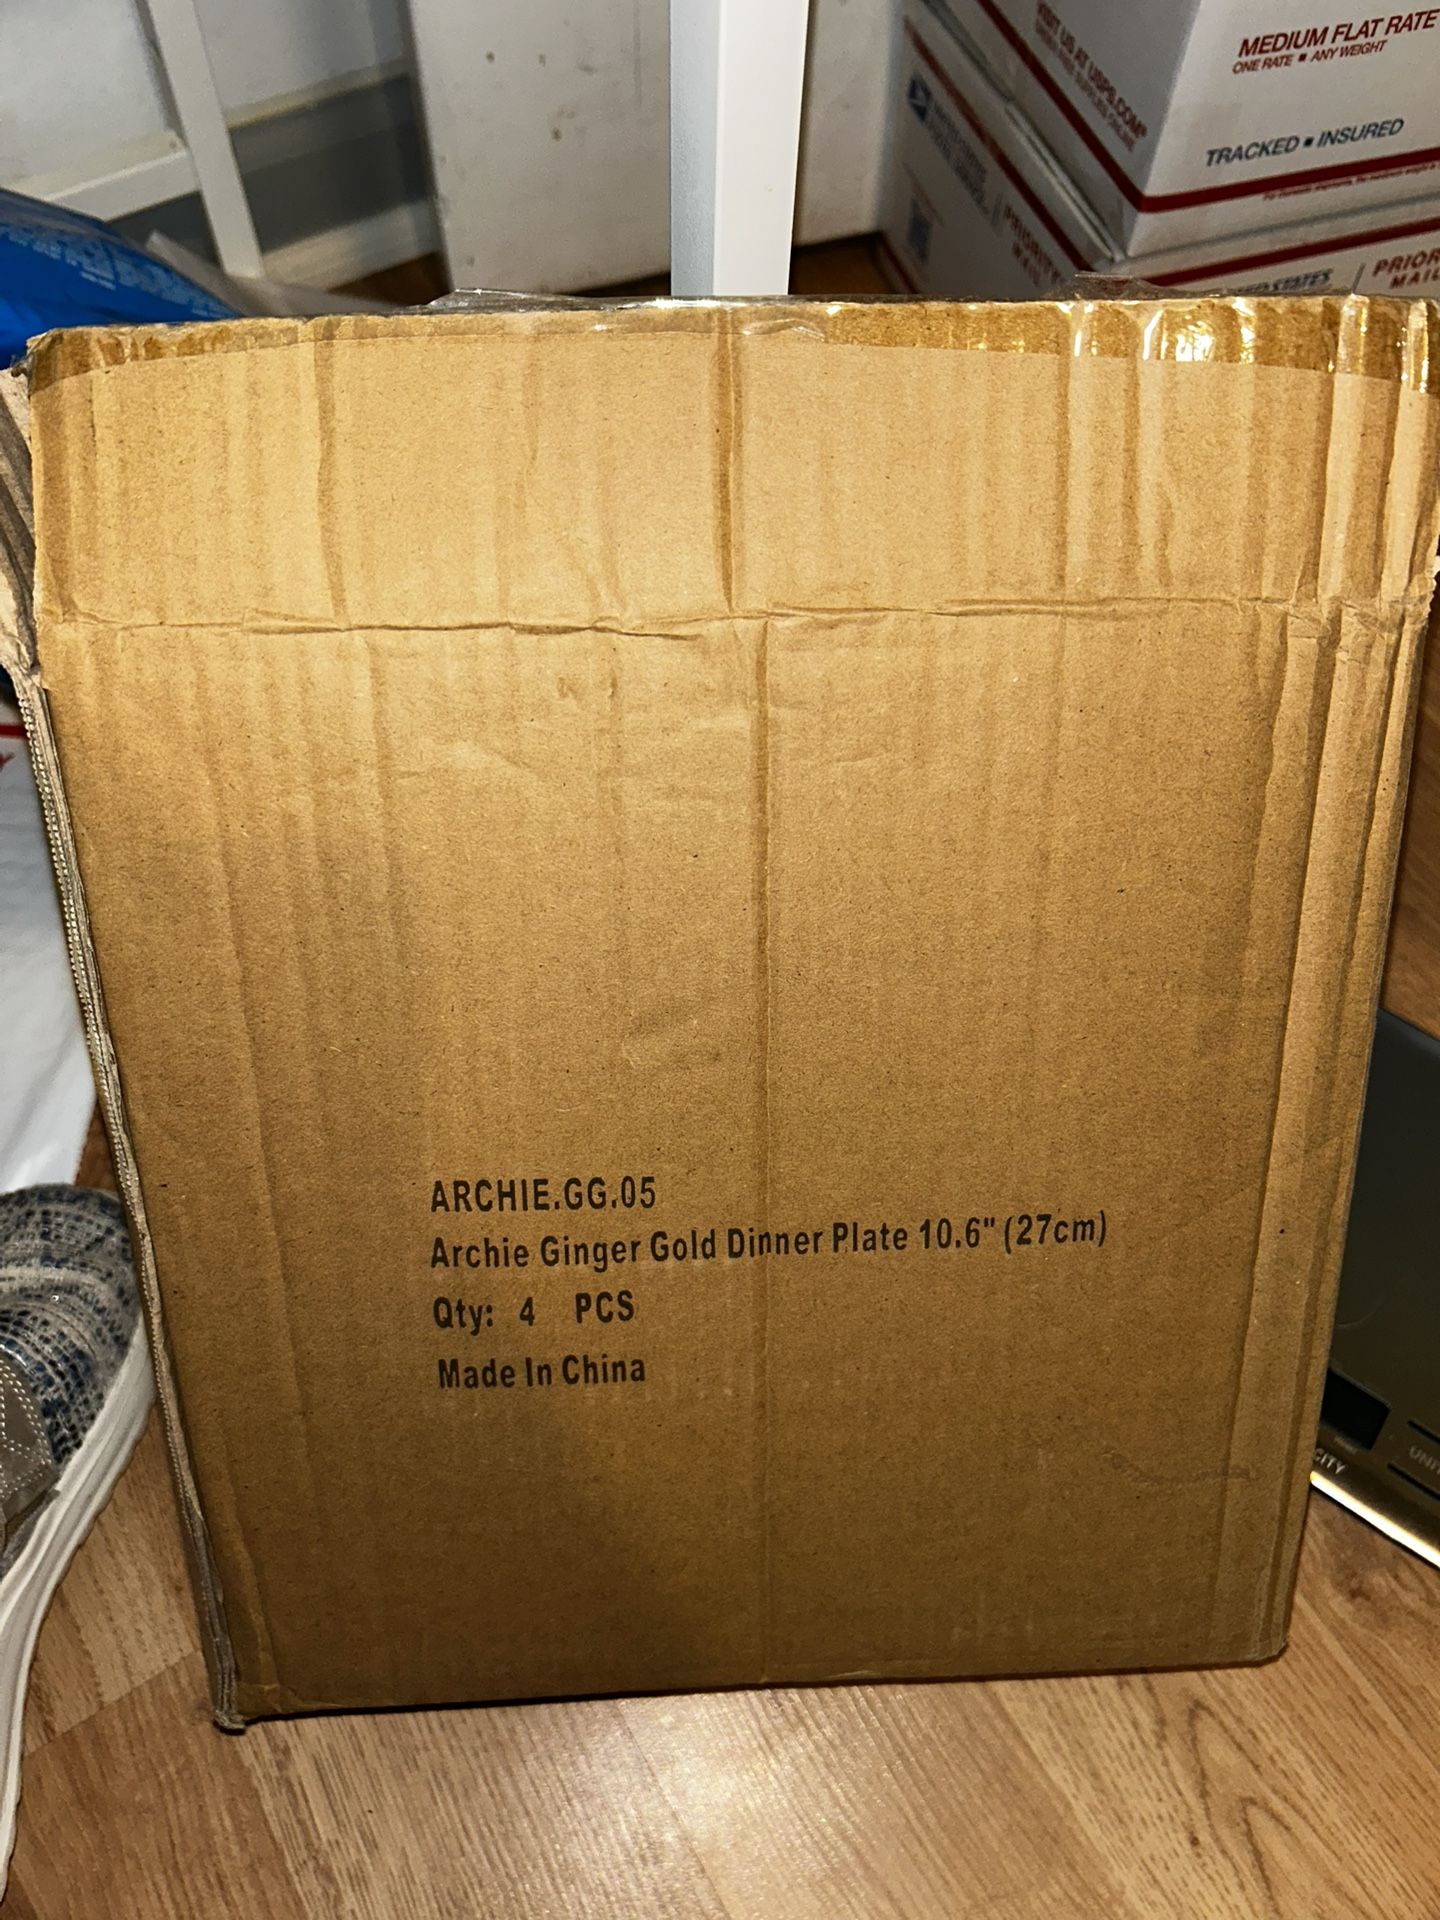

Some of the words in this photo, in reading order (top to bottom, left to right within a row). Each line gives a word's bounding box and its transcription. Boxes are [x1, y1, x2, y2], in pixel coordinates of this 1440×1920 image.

[1232, 58, 1259, 75] ONE
[1261, 53, 1294, 70] RATE
[1310, 47, 1340, 63] ANY
[1339, 39, 1388, 58] WEIGHT
[1238, 26, 1329, 58] MEDIUM
[1331, 17, 1384, 44] FLAT
[1385, 8, 1440, 36] RATE
[1205, 135, 1300, 167] TRACKED
[1317, 117, 1405, 149] INSURED
[430, 1175, 657, 1214] ARCHIE.GG.05
[430, 1236, 531, 1269] Archie
[540, 1235, 643, 1275] Ginger
[649, 1228, 718, 1263] Gold
[727, 1227, 825, 1259] Dinner
[832, 1221, 909, 1254] Plate
[918, 1216, 997, 1250] 10.6"
[1003, 1209, 1108, 1255] (27cm)
[432, 1296, 495, 1337] Qty:
[518, 1296, 537, 1327] 4
[574, 1289, 636, 1325] PCS
[437, 1357, 517, 1390] Made
[525, 1356, 554, 1388] In
[561, 1353, 647, 1386] China
